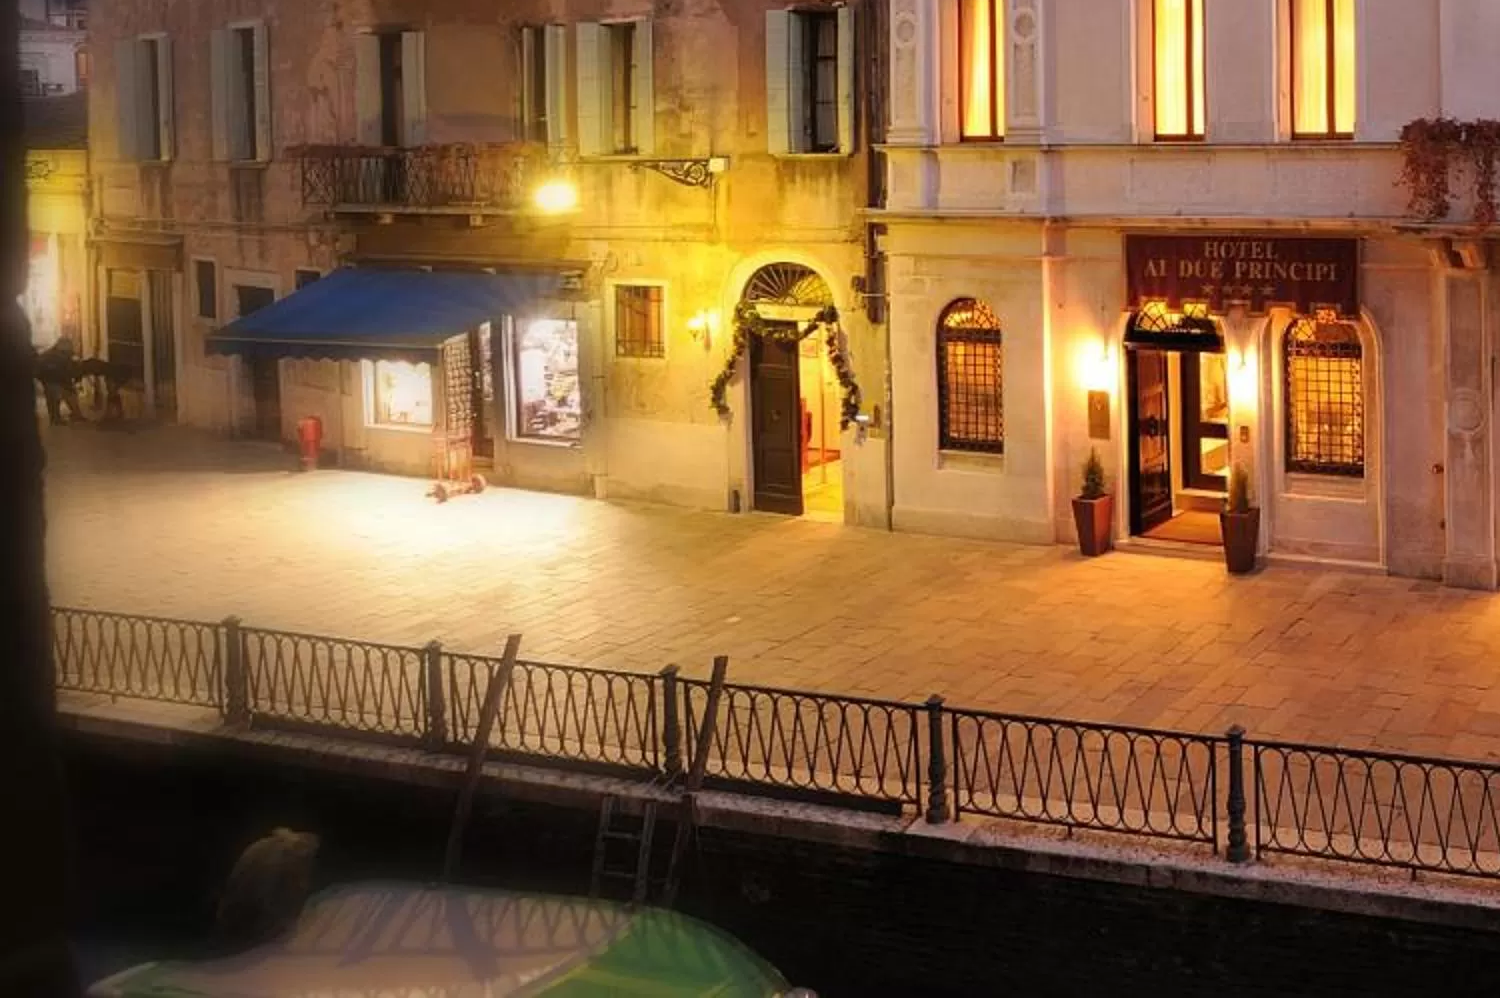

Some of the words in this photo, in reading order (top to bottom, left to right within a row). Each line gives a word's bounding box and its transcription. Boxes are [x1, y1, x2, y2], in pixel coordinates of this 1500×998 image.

[1204, 241, 1278, 258] HOTEL
[1144, 260, 1166, 277] AI
[1179, 262, 1225, 278] DUE
[1235, 262, 1337, 282] PRINCIPI
